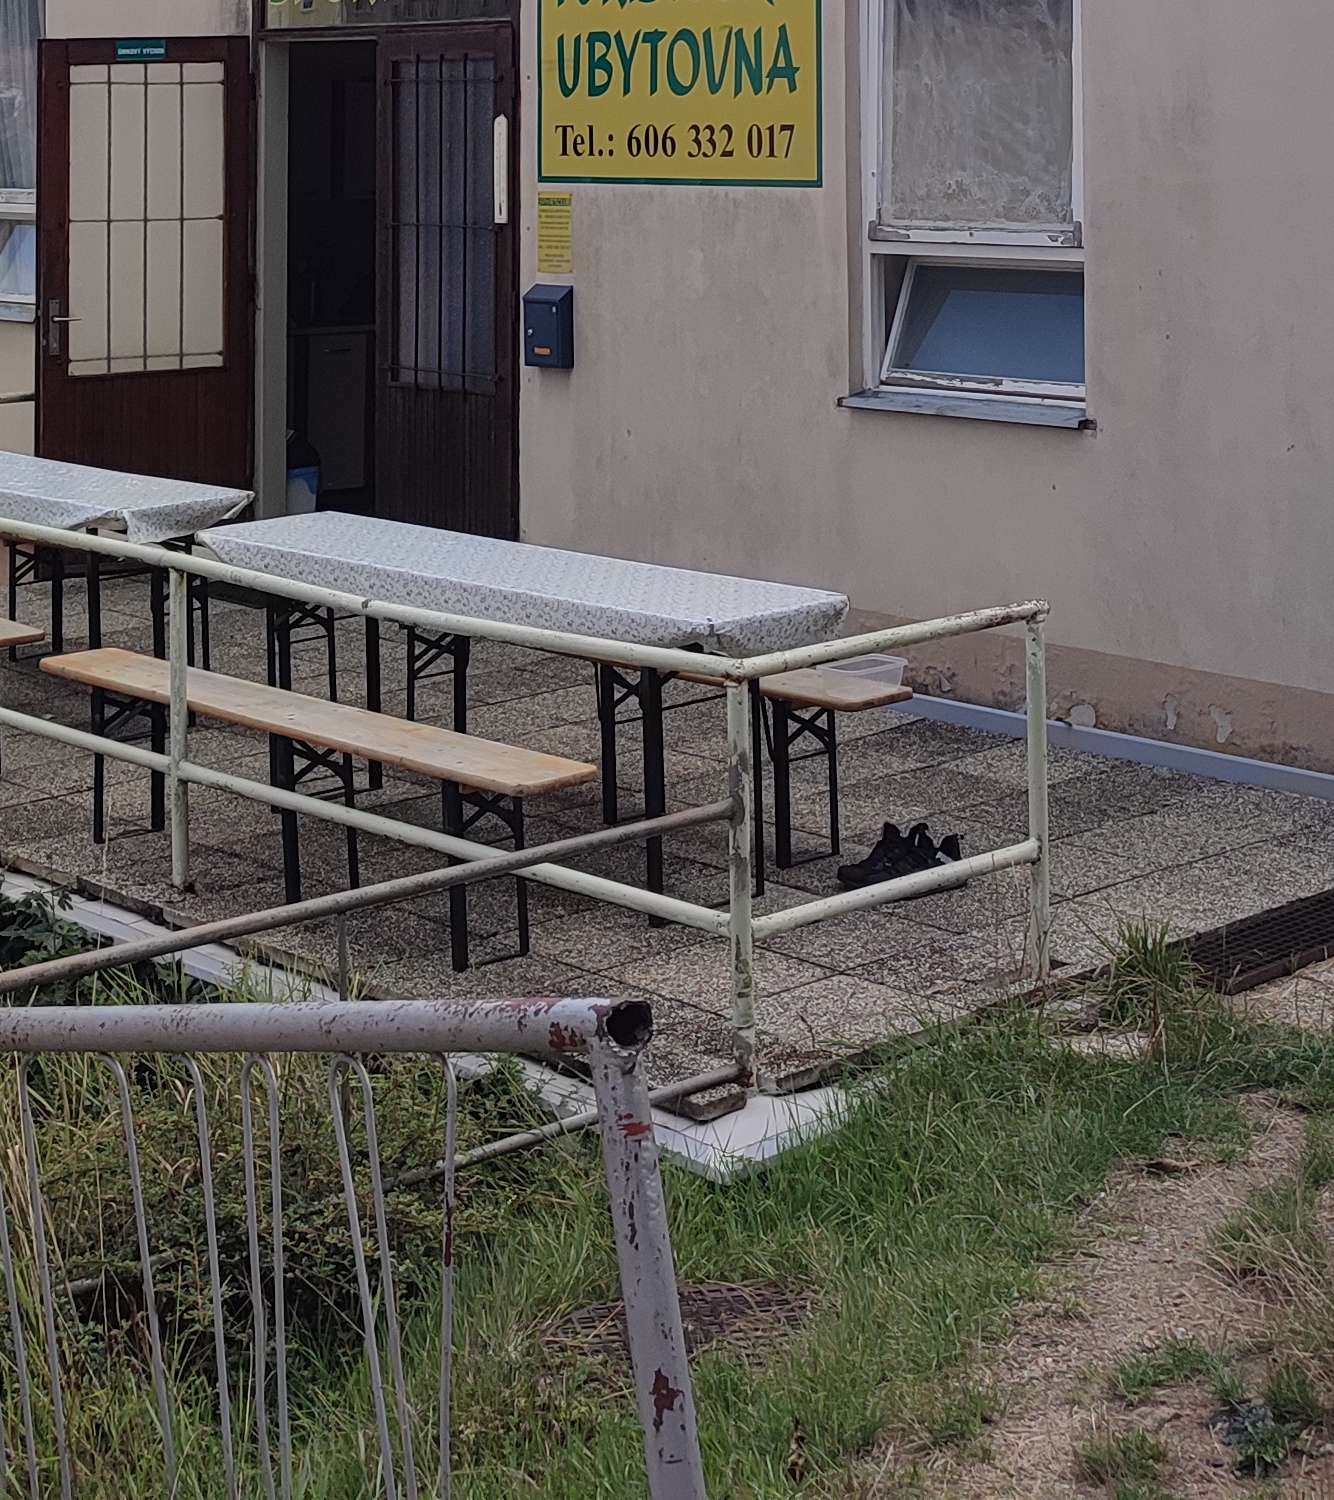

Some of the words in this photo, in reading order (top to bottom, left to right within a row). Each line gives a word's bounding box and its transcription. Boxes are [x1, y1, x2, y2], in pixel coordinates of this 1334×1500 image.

[556, 23, 801, 100] UBYTOVNA
[554, 125, 615, 157] Tel.:
[627, 124, 677, 158] 606
[687, 124, 735, 159] 332
[746, 124, 796, 159] 017
